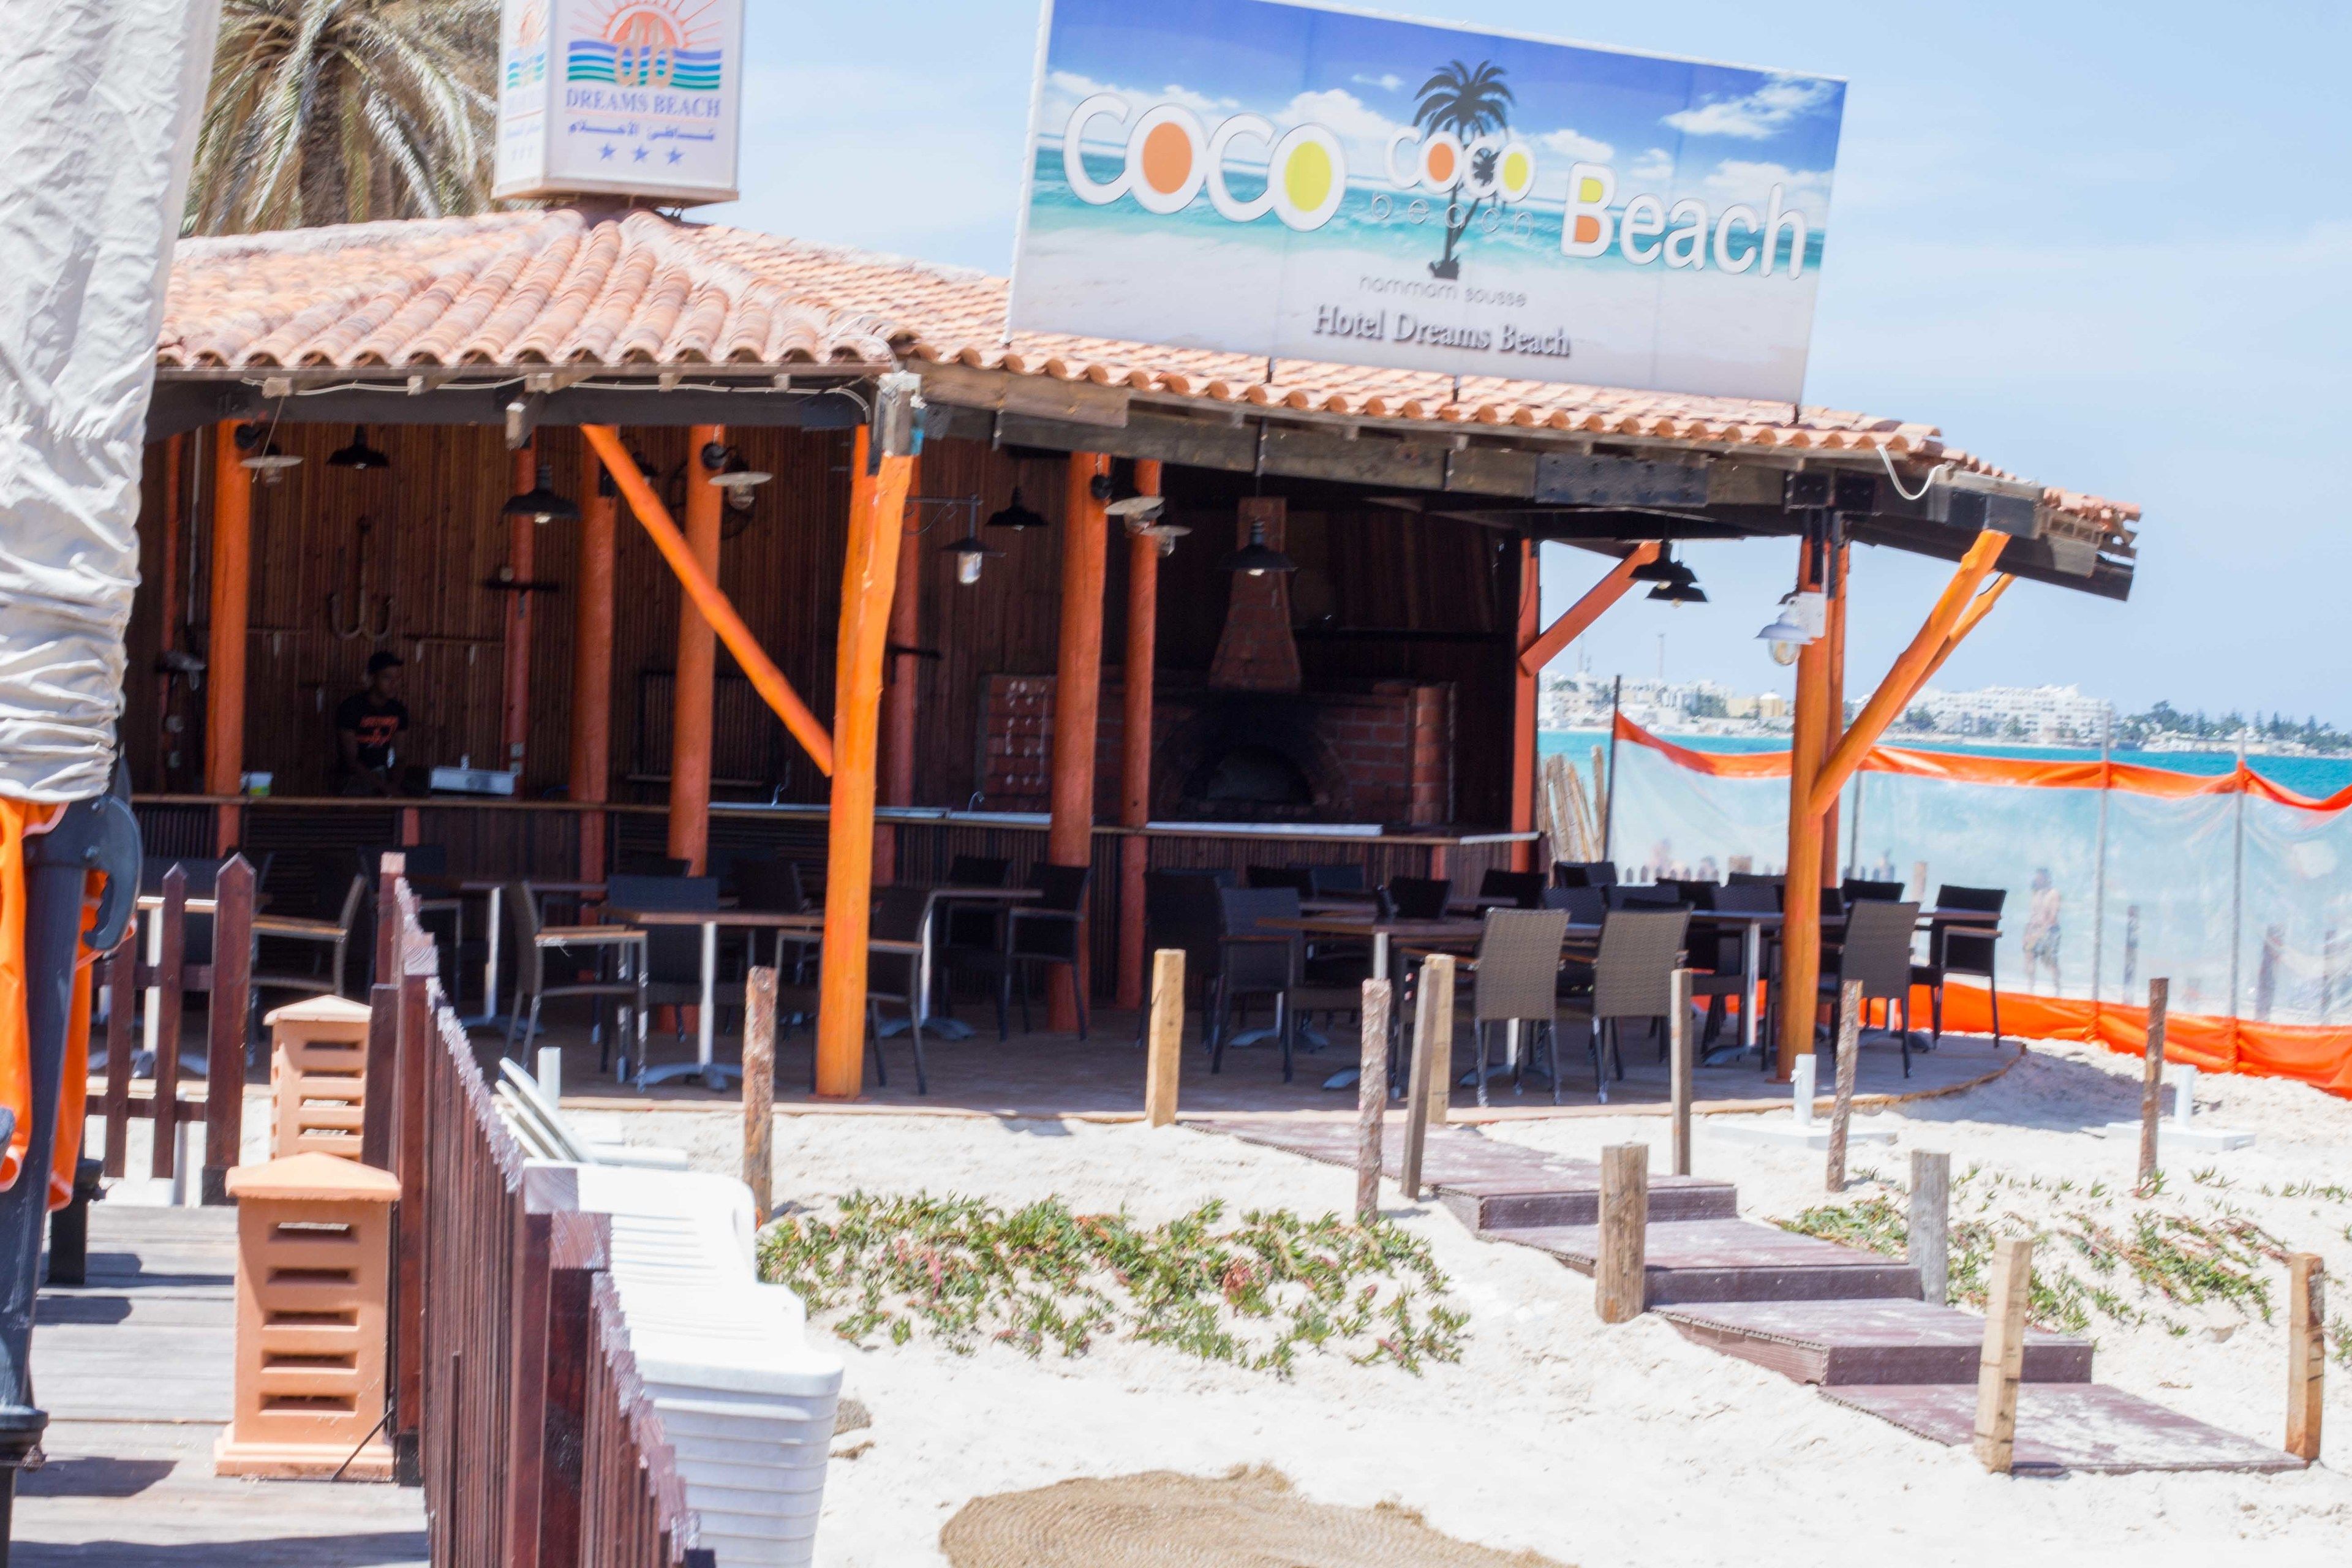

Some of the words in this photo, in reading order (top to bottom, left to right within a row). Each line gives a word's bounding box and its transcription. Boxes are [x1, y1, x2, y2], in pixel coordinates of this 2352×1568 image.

[566, 88, 648, 111] DREAMS
[654, 94, 721, 117] BEACH
[1560, 161, 1807, 279] Beach
[1466, 286, 1527, 307] sousse
[1313, 304, 1386, 339] Hotel
[1392, 313, 1491, 350] Dreams
[1498, 323, 1571, 355] Beach
